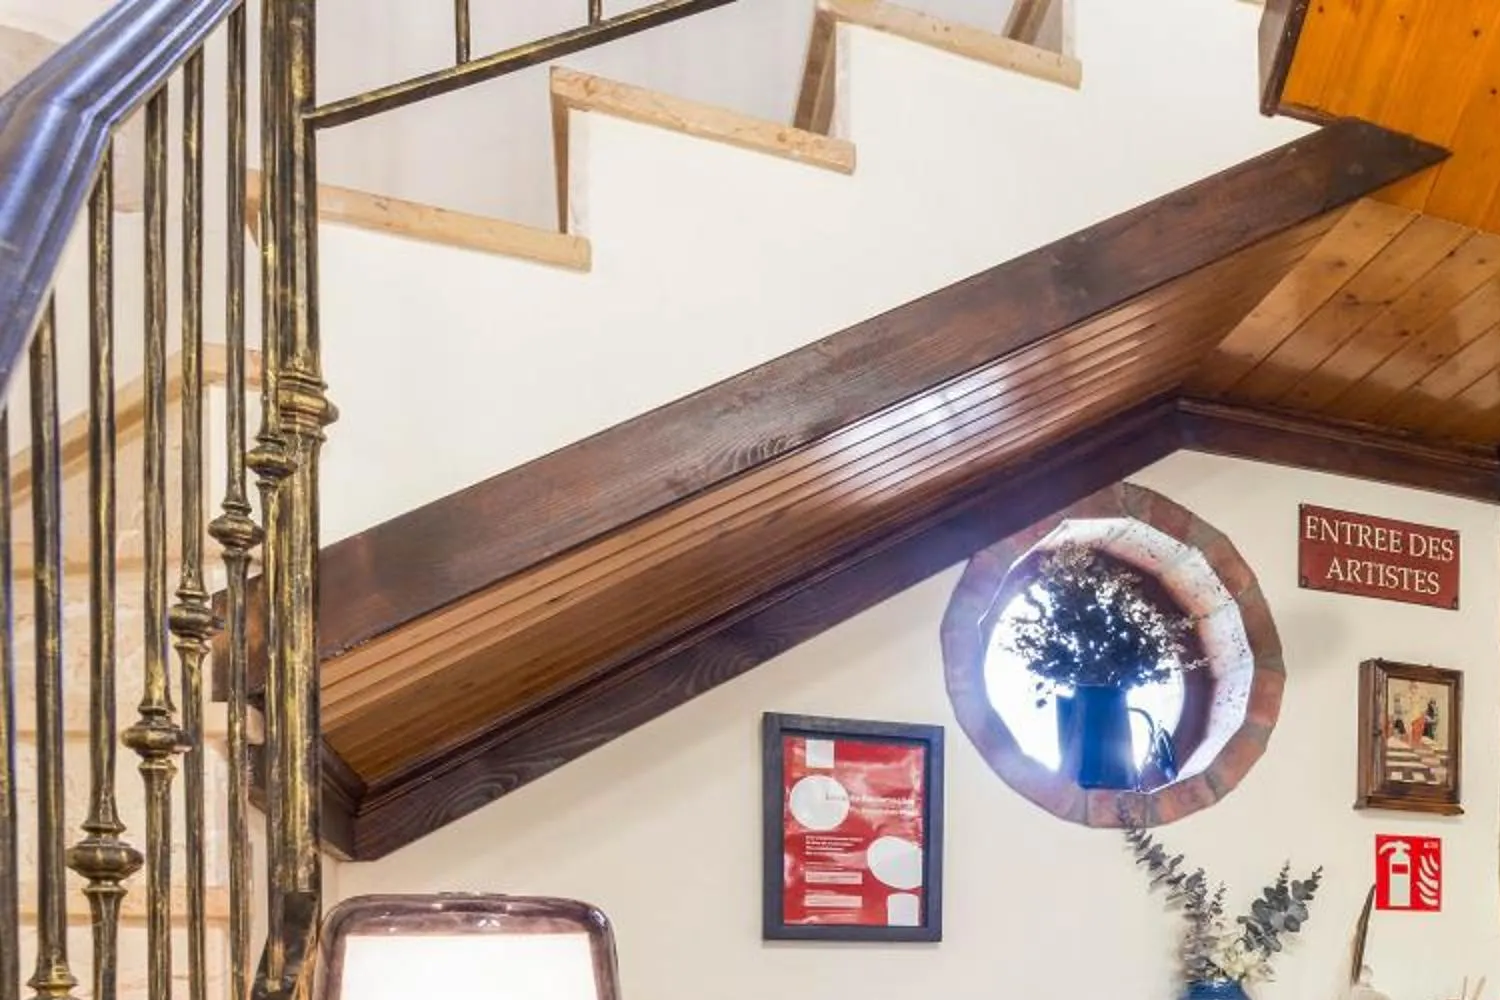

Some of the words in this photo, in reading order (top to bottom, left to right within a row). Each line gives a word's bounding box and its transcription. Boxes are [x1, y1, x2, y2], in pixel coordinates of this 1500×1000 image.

[1305, 515, 1403, 553] ENTREE
[1409, 533, 1454, 562] DES
[1325, 556, 1440, 595] ARTISTES
